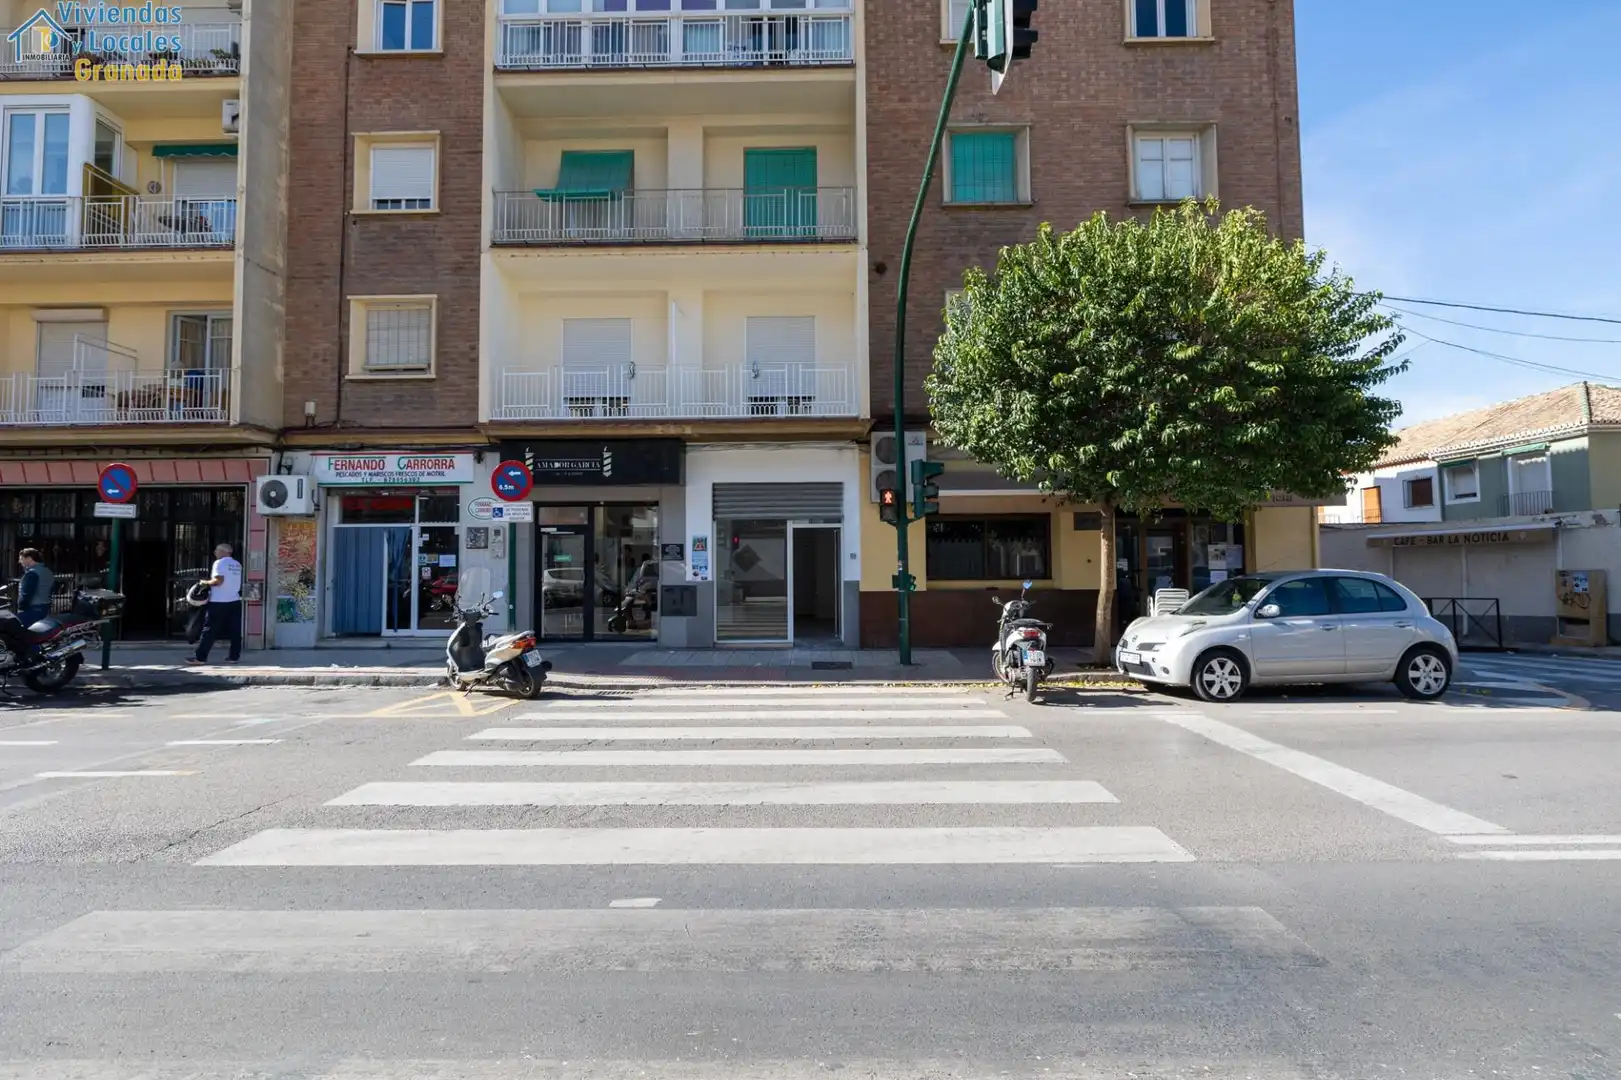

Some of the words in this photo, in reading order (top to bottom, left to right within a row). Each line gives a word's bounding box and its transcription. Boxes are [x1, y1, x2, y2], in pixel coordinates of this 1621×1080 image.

[328, 456, 386, 471] FERNANDO
[397, 455, 455, 470] CARRORRA
[536, 461, 570, 469] AMADOR
[1427, 535, 1444, 545] BAR
[1448, 535, 1460, 544] LA
[1464, 532, 1510, 544] NOTICIA
